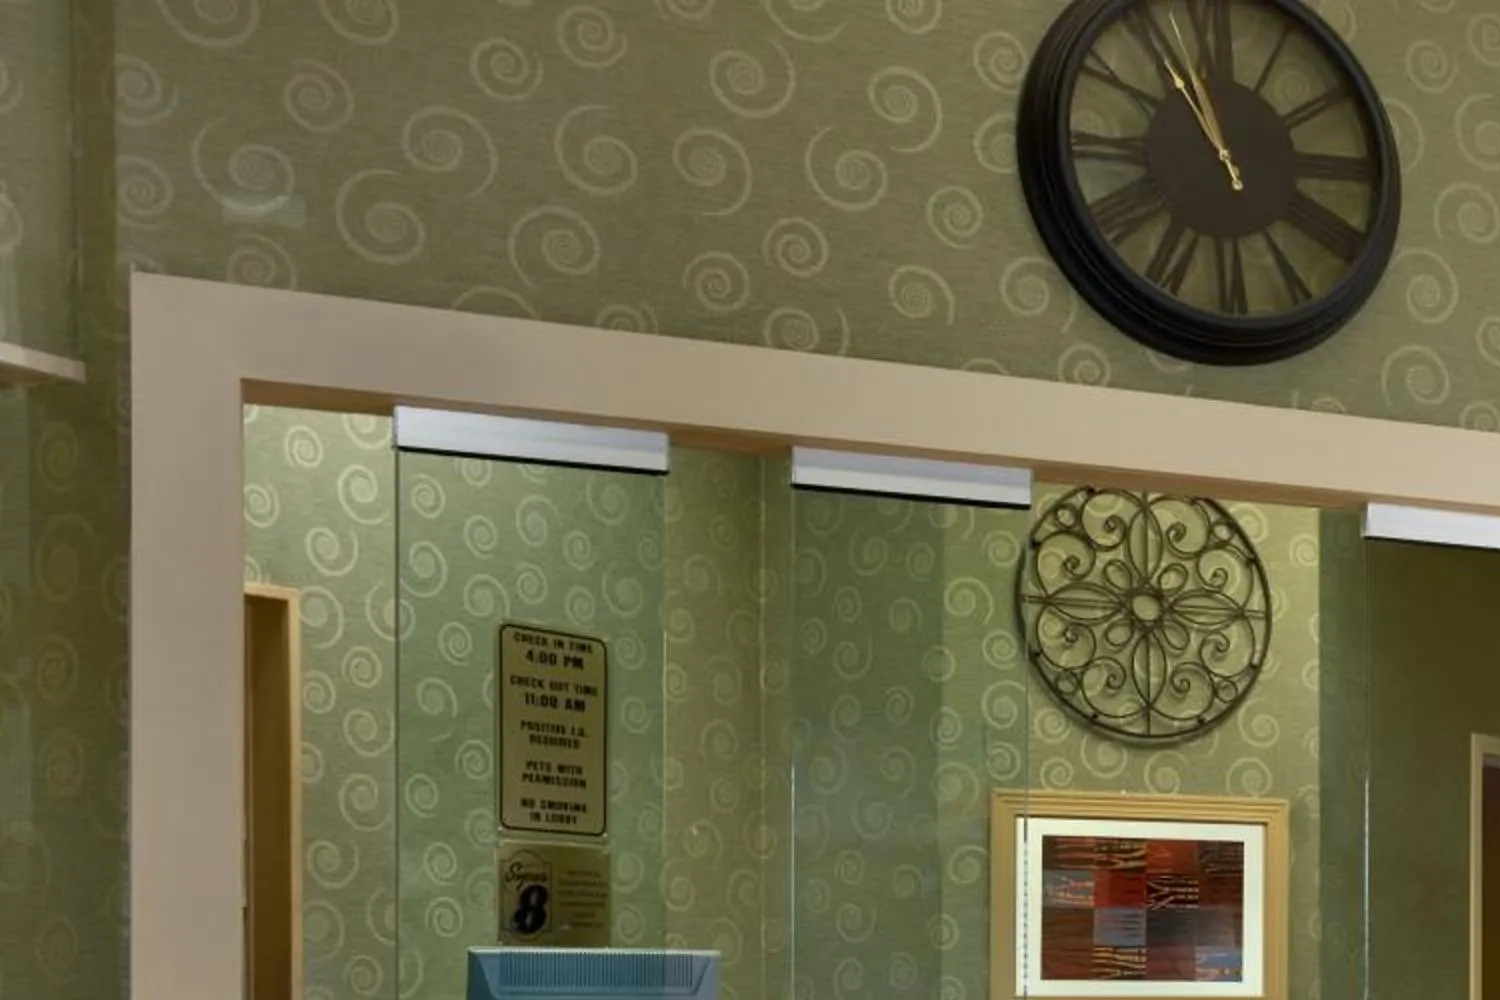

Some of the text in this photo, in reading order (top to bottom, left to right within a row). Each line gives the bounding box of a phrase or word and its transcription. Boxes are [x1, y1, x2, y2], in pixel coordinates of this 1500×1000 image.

[513, 632, 593, 653] CHECK IN TIME
[525, 649, 585, 670] 4:00 PM
[510, 674, 598, 697] CHECK OUT TIME
[525, 692, 586, 712] 11:00 AM
[526, 760, 583, 775] PETS WITH
[522, 772, 587, 789] PERMISSION
[521, 798, 587, 813] NO SMOKING
[529, 811, 577, 824] IN LOBBY
[511, 884, 548, 936] 8
